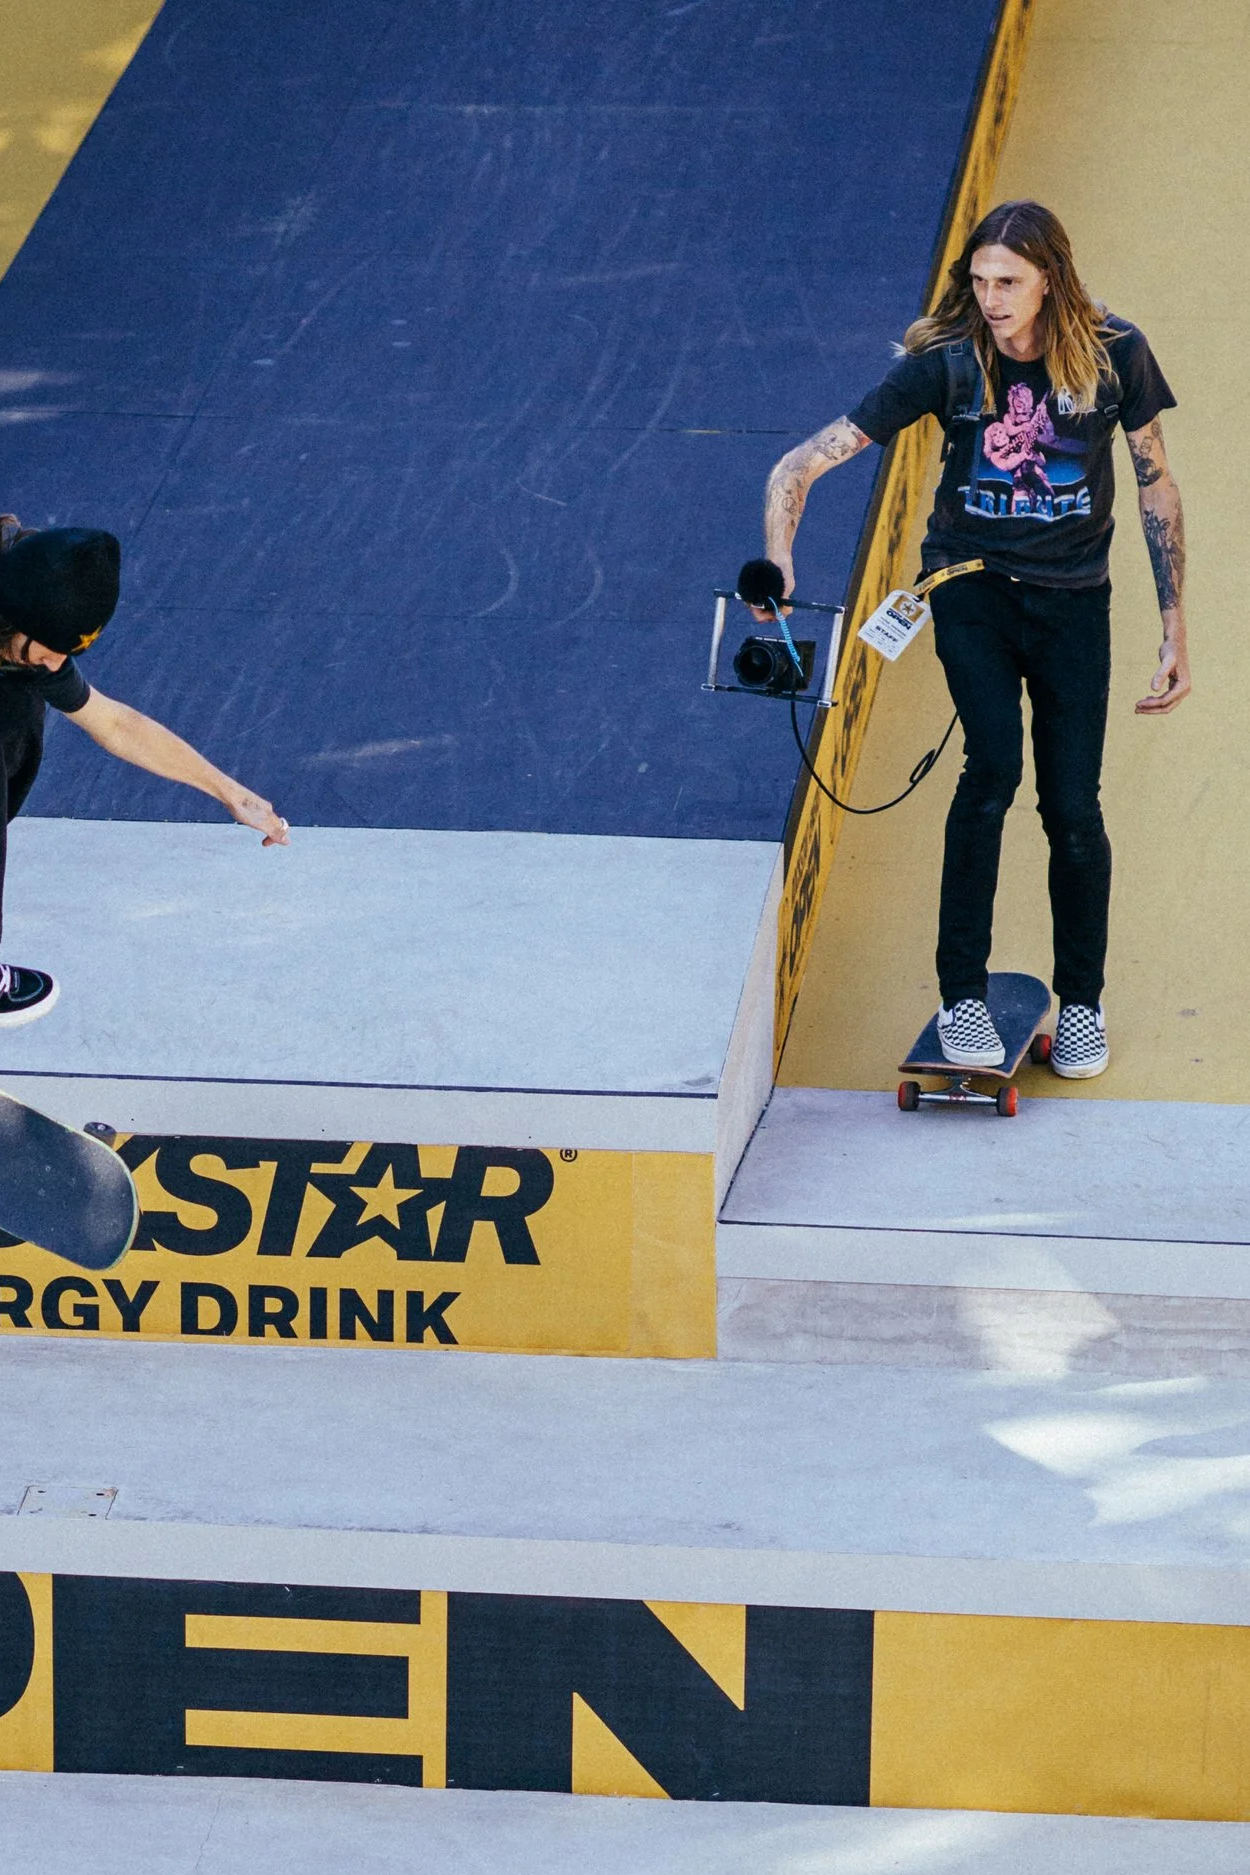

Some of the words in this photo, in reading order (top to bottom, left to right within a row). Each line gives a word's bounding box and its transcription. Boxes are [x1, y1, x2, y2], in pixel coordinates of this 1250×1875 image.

[958, 486, 1091, 521] TRIBUTE
[875, 625, 899, 642] STAFF
[886, 610, 912, 631] OPEN
[180, 1280, 461, 1345] DRINK
